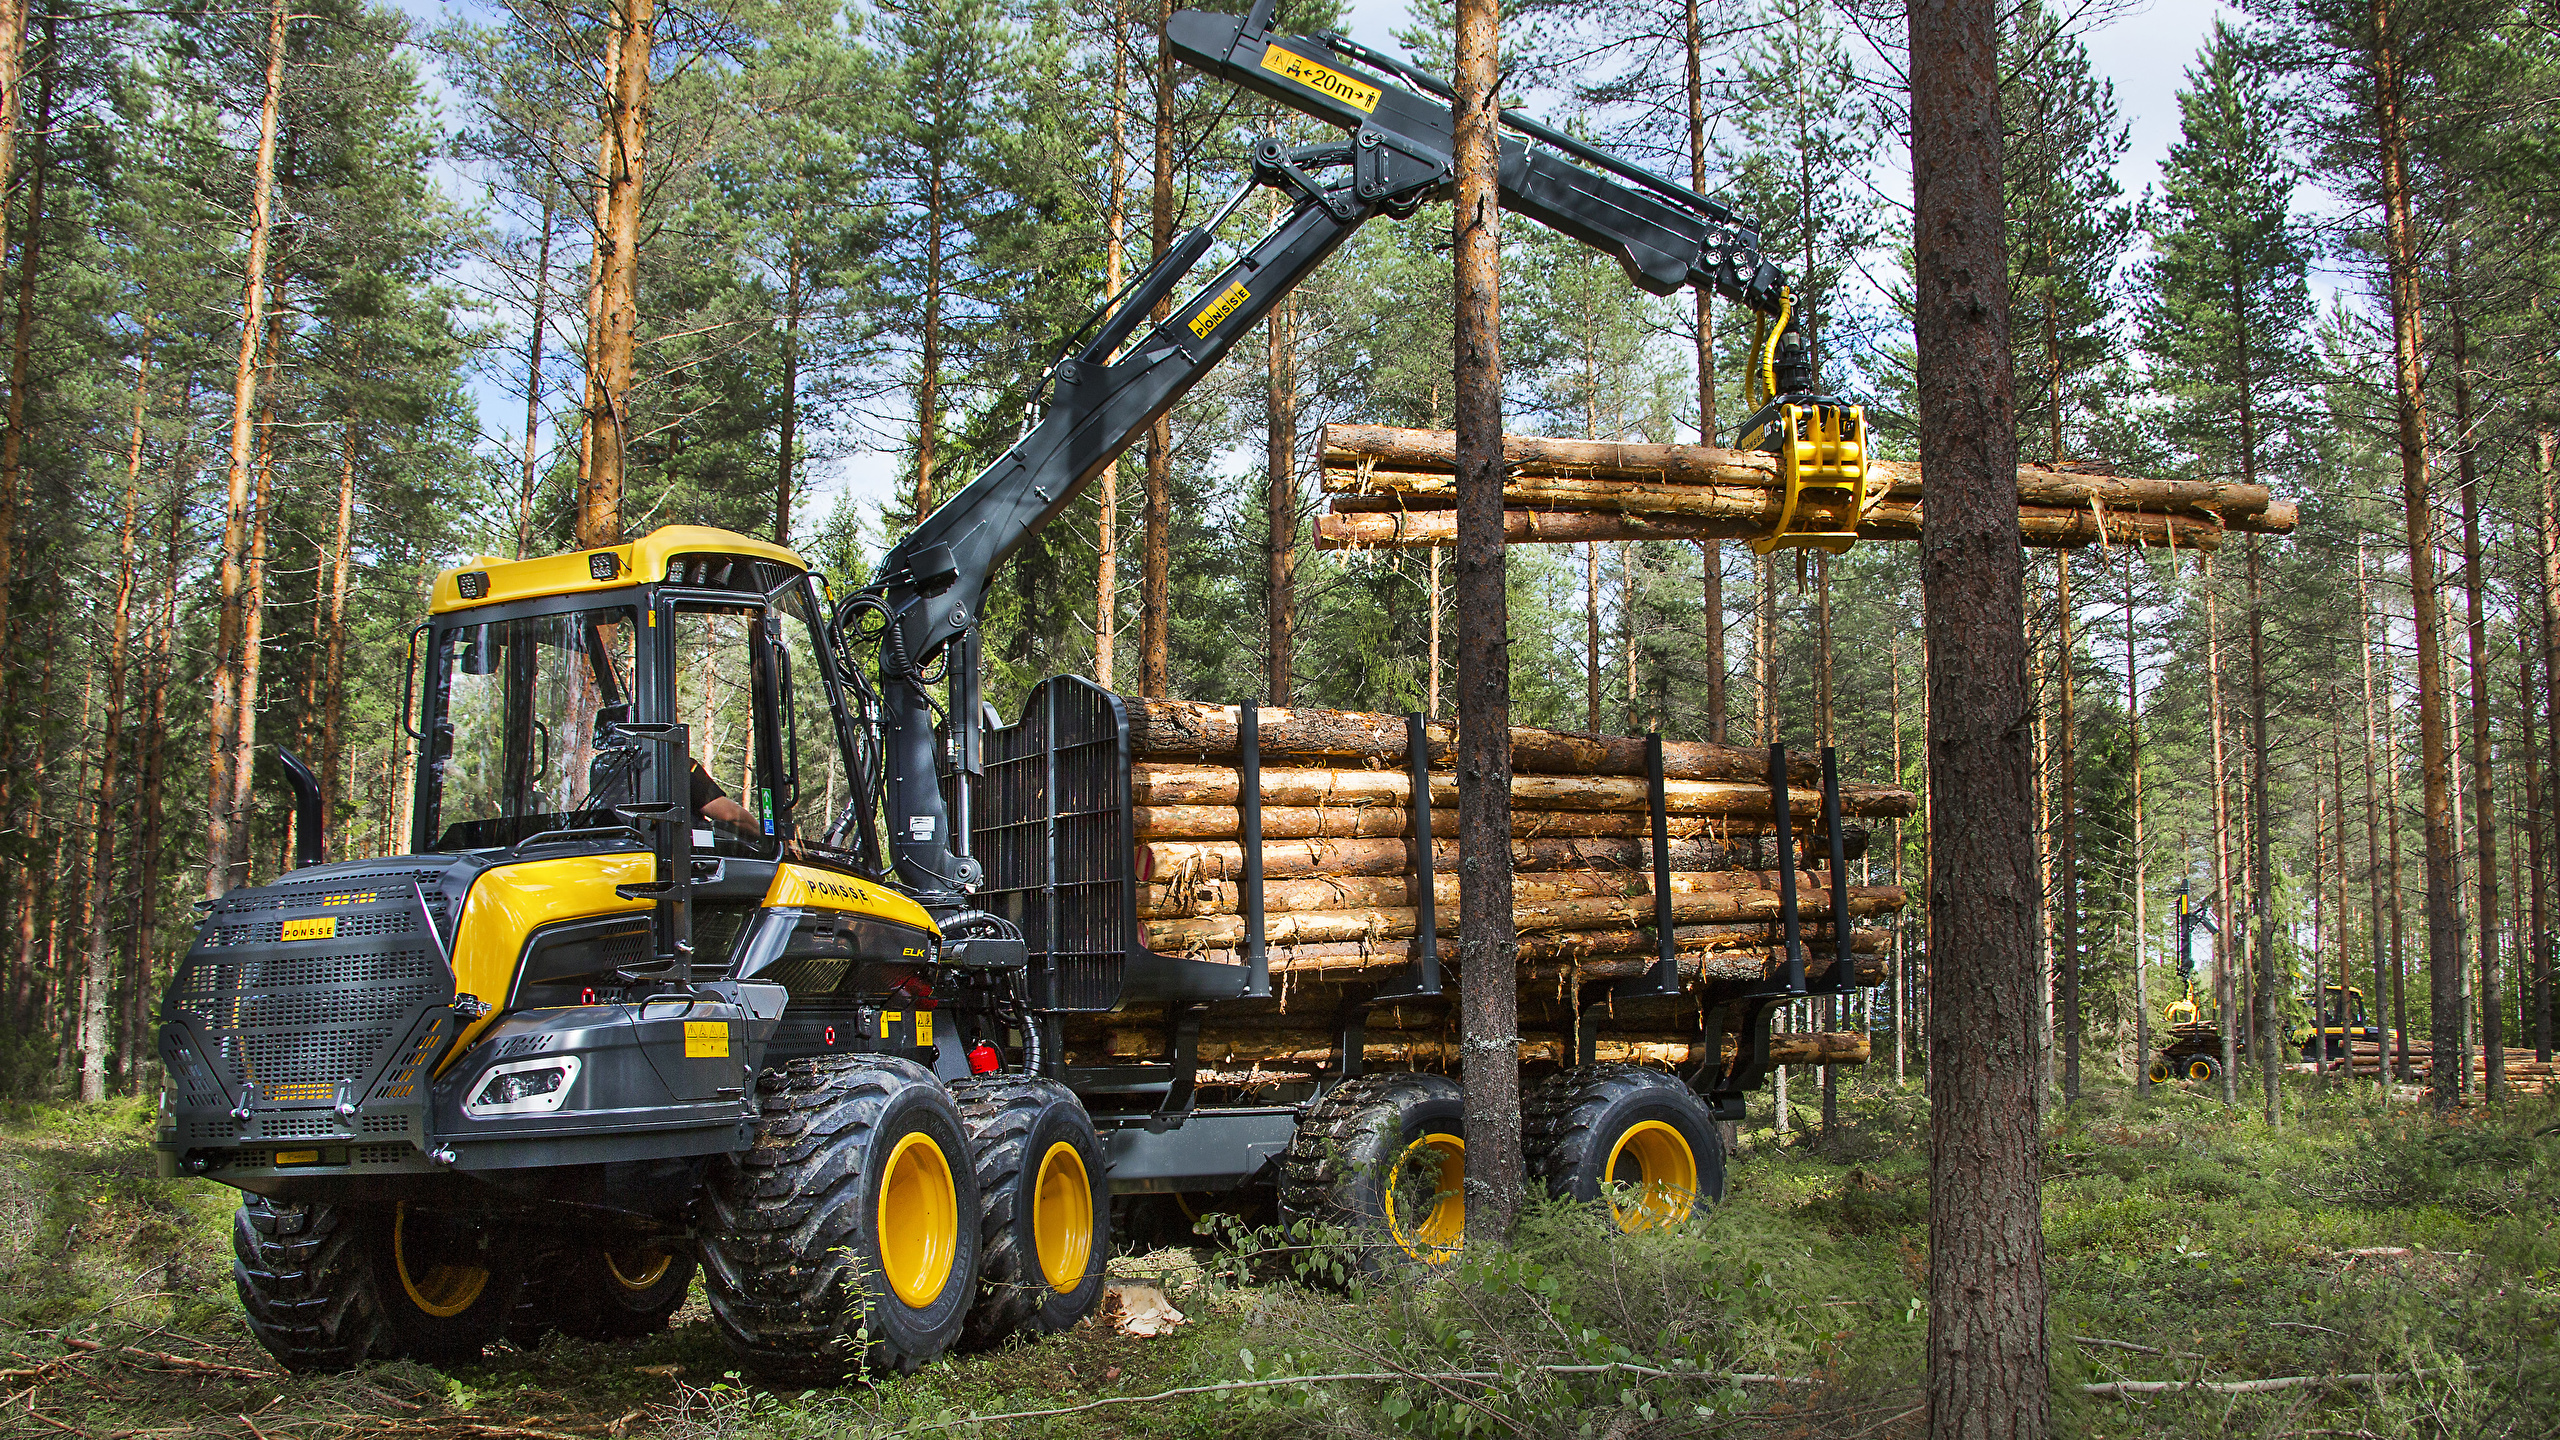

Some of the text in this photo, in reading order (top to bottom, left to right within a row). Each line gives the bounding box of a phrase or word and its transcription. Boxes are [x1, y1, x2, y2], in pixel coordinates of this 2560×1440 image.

[1311, 69, 1354, 99] 20m
[1196, 289, 1248, 337] PONSSE
[807, 880, 868, 901] PONSSE
[284, 927, 333, 938] PONSSE
[902, 947, 926, 958] ELK
